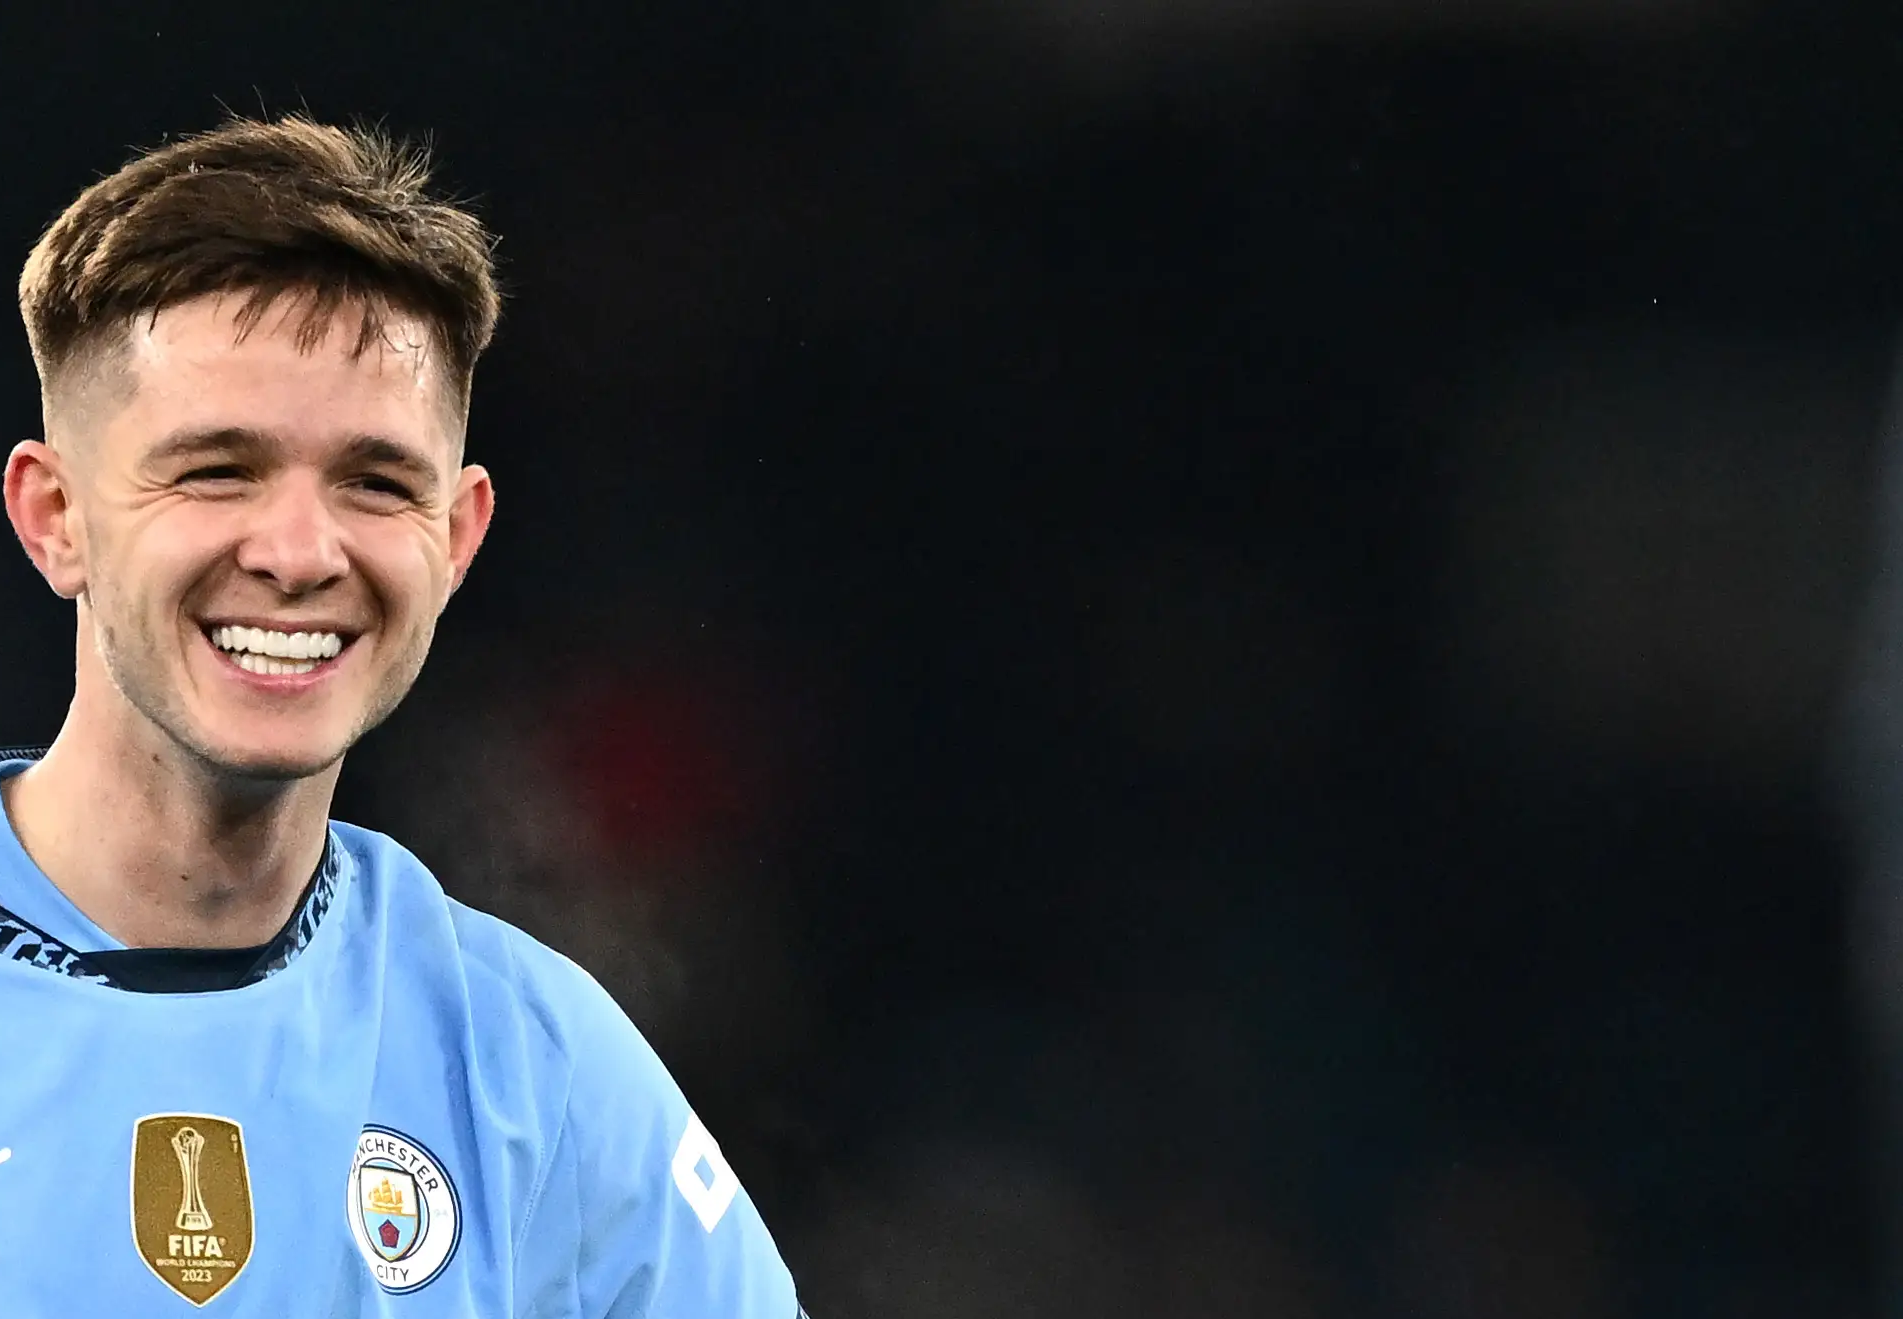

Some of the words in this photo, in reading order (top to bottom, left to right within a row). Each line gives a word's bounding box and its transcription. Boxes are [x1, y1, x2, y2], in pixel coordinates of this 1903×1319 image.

[168, 1235, 223, 1258] FIFA
[180, 1268, 213, 1282] 2023
[376, 1264, 410, 1282] CITY
